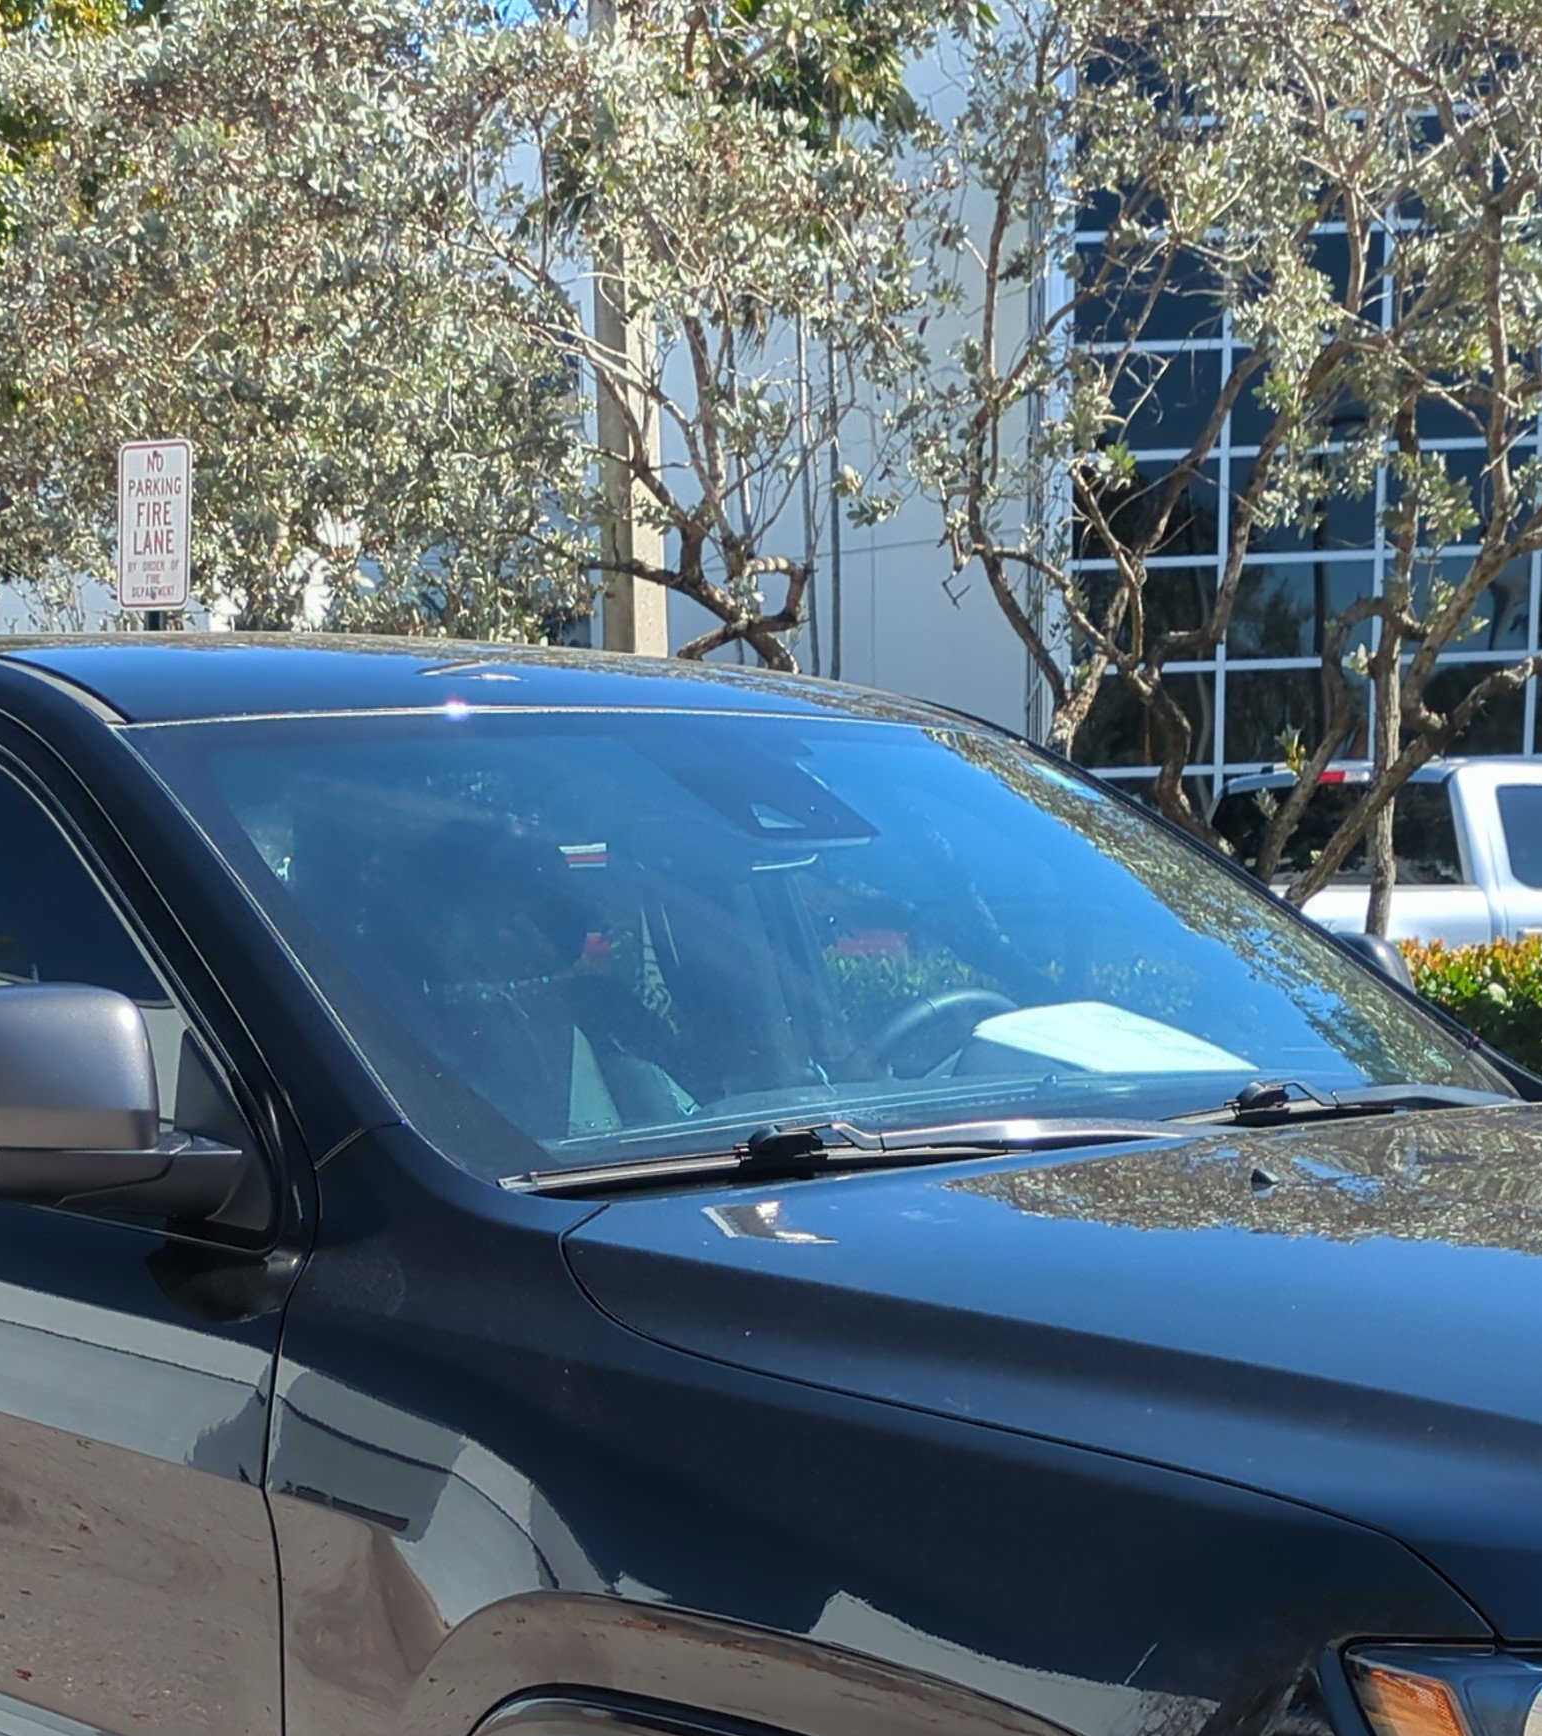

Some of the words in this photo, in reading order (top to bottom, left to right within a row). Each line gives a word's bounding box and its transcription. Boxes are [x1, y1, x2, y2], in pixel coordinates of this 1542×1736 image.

[146, 454, 165, 473] NO
[128, 476, 182, 497] PARKING
[137, 501, 172, 527] FIRE
[133, 530, 175, 556] LANE
